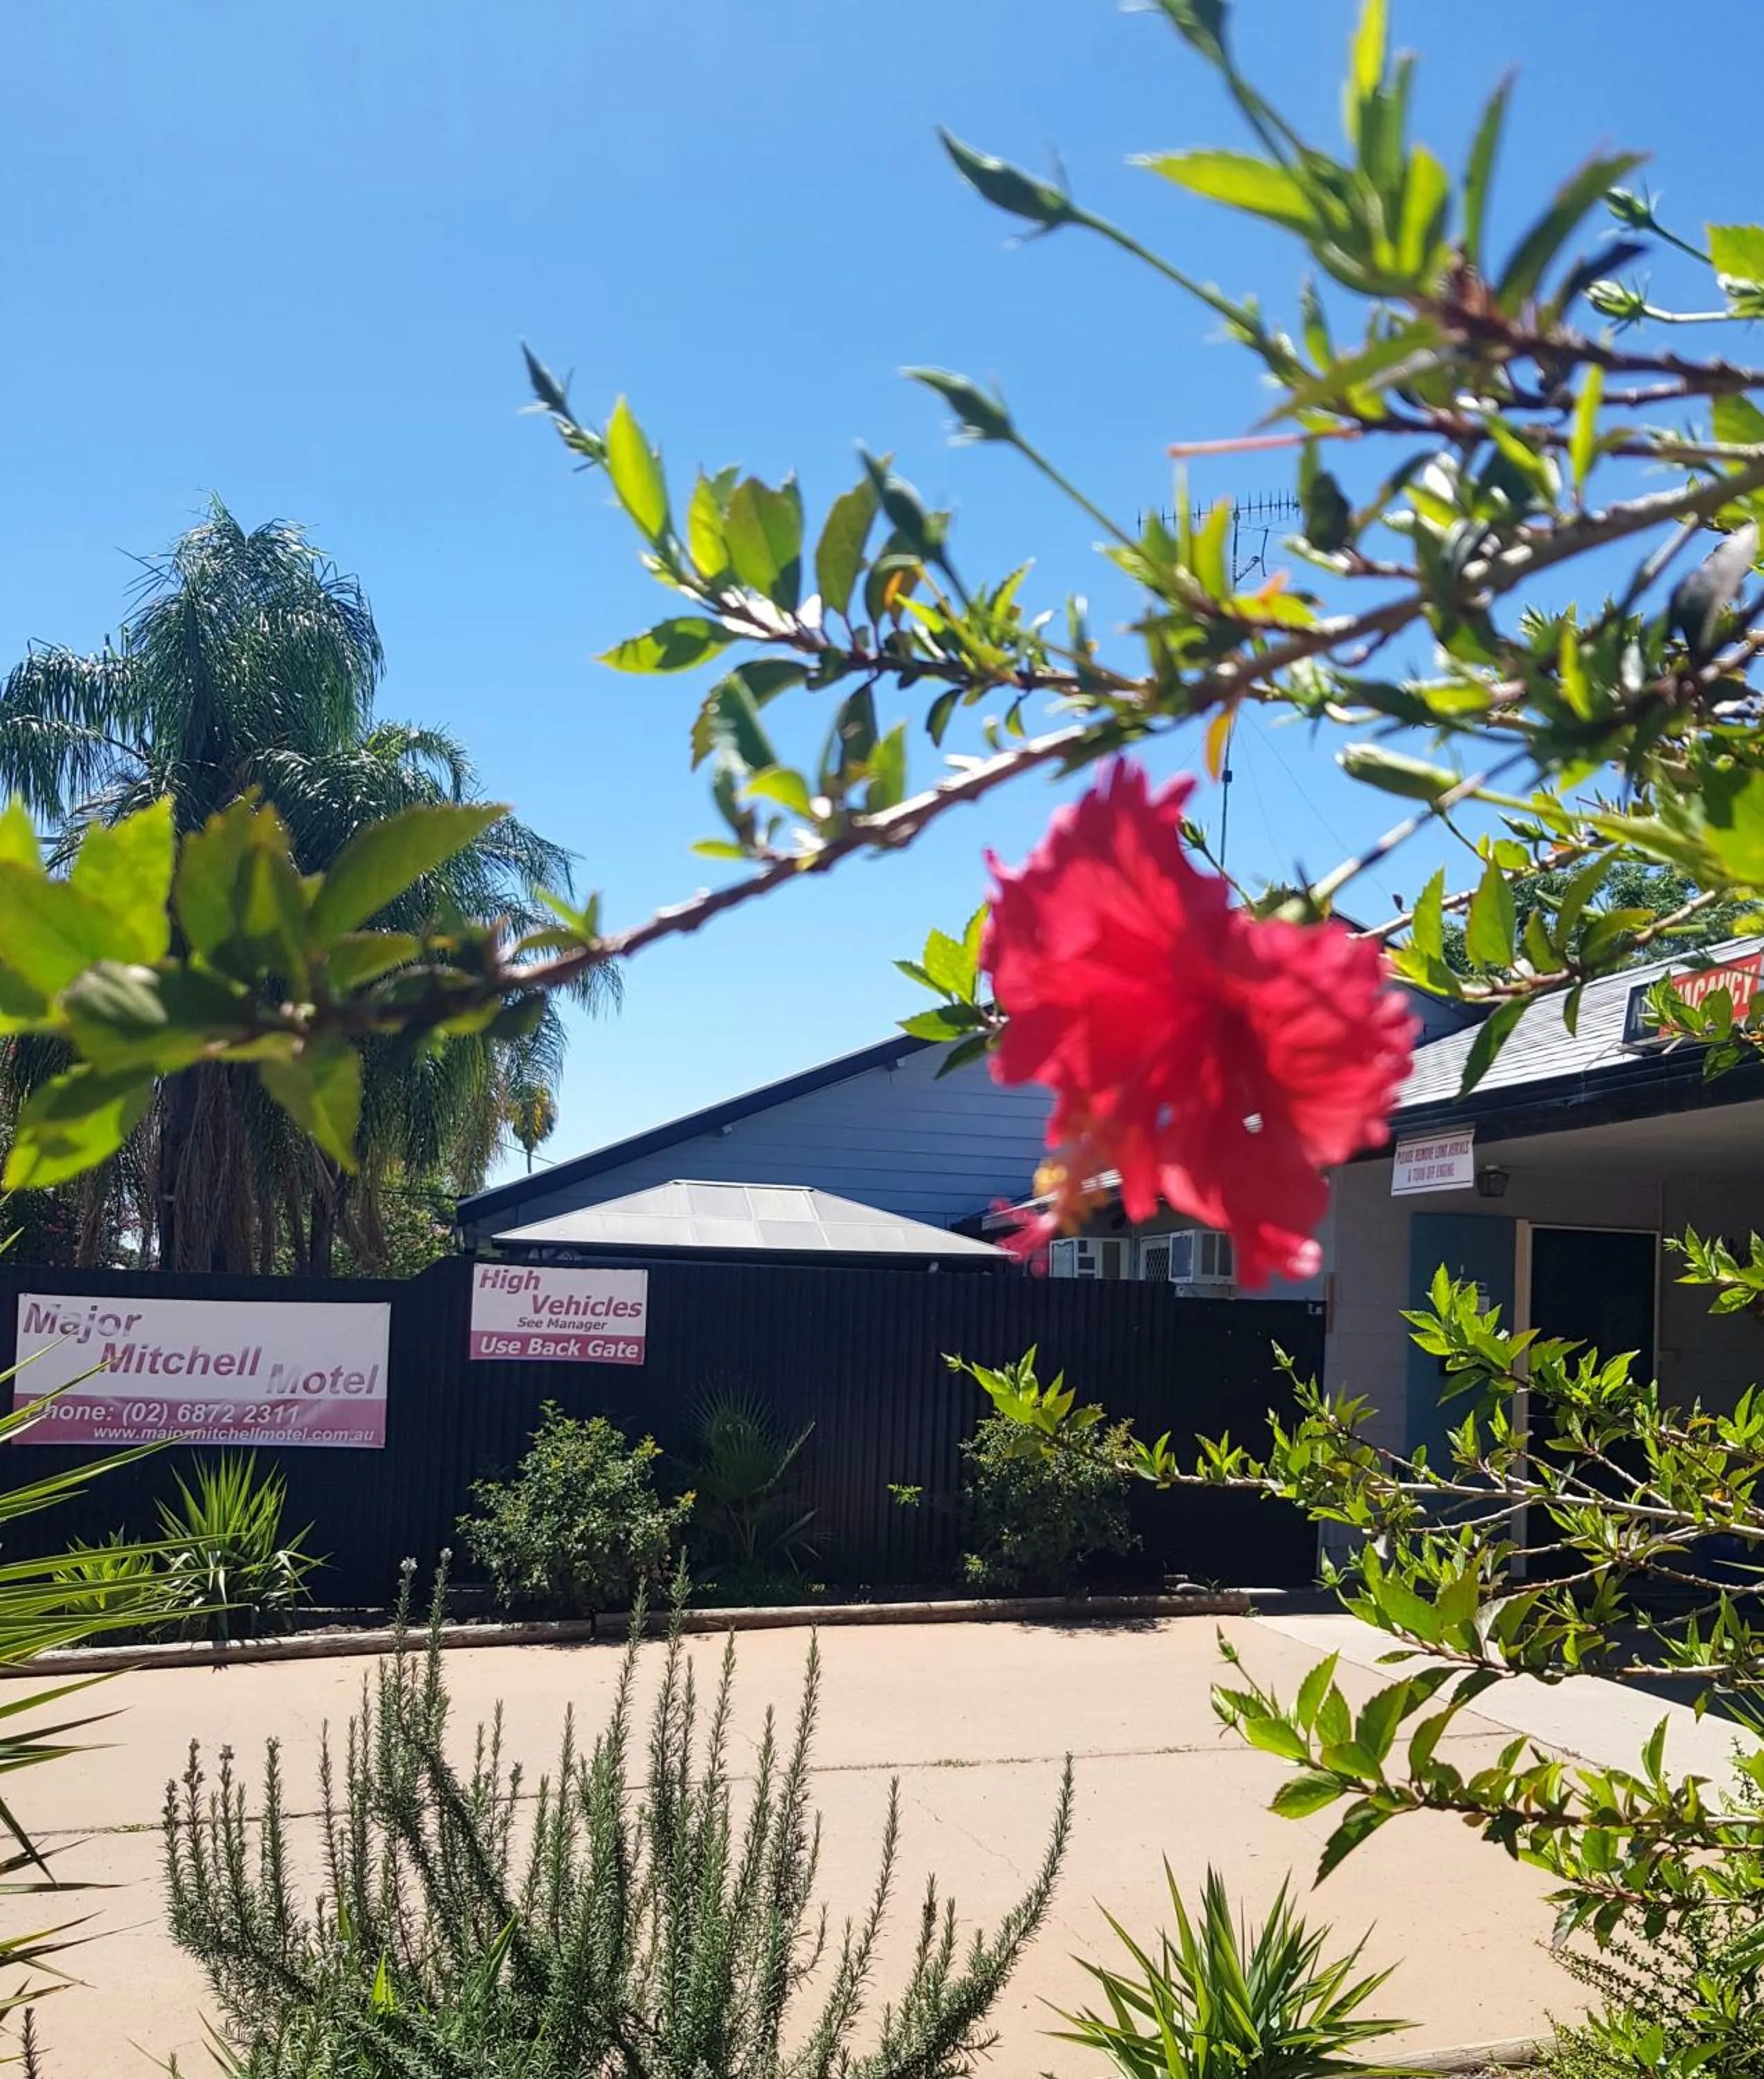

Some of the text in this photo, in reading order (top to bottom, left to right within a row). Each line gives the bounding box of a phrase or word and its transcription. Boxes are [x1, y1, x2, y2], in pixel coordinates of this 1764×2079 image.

[479, 1268, 541, 1295] High
[532, 1294, 643, 1318] Vehicles
[23, 1302, 143, 1344] Major
[517, 1317, 608, 1333] See Manager
[100, 1342, 263, 1376] Mitchell
[480, 1337, 639, 1358] Use Back Gate
[266, 1363, 379, 1394] Motel
[122, 1402, 169, 1426] (02)
[177, 1403, 235, 1423] 6872
[243, 1405, 300, 1424] 2311
